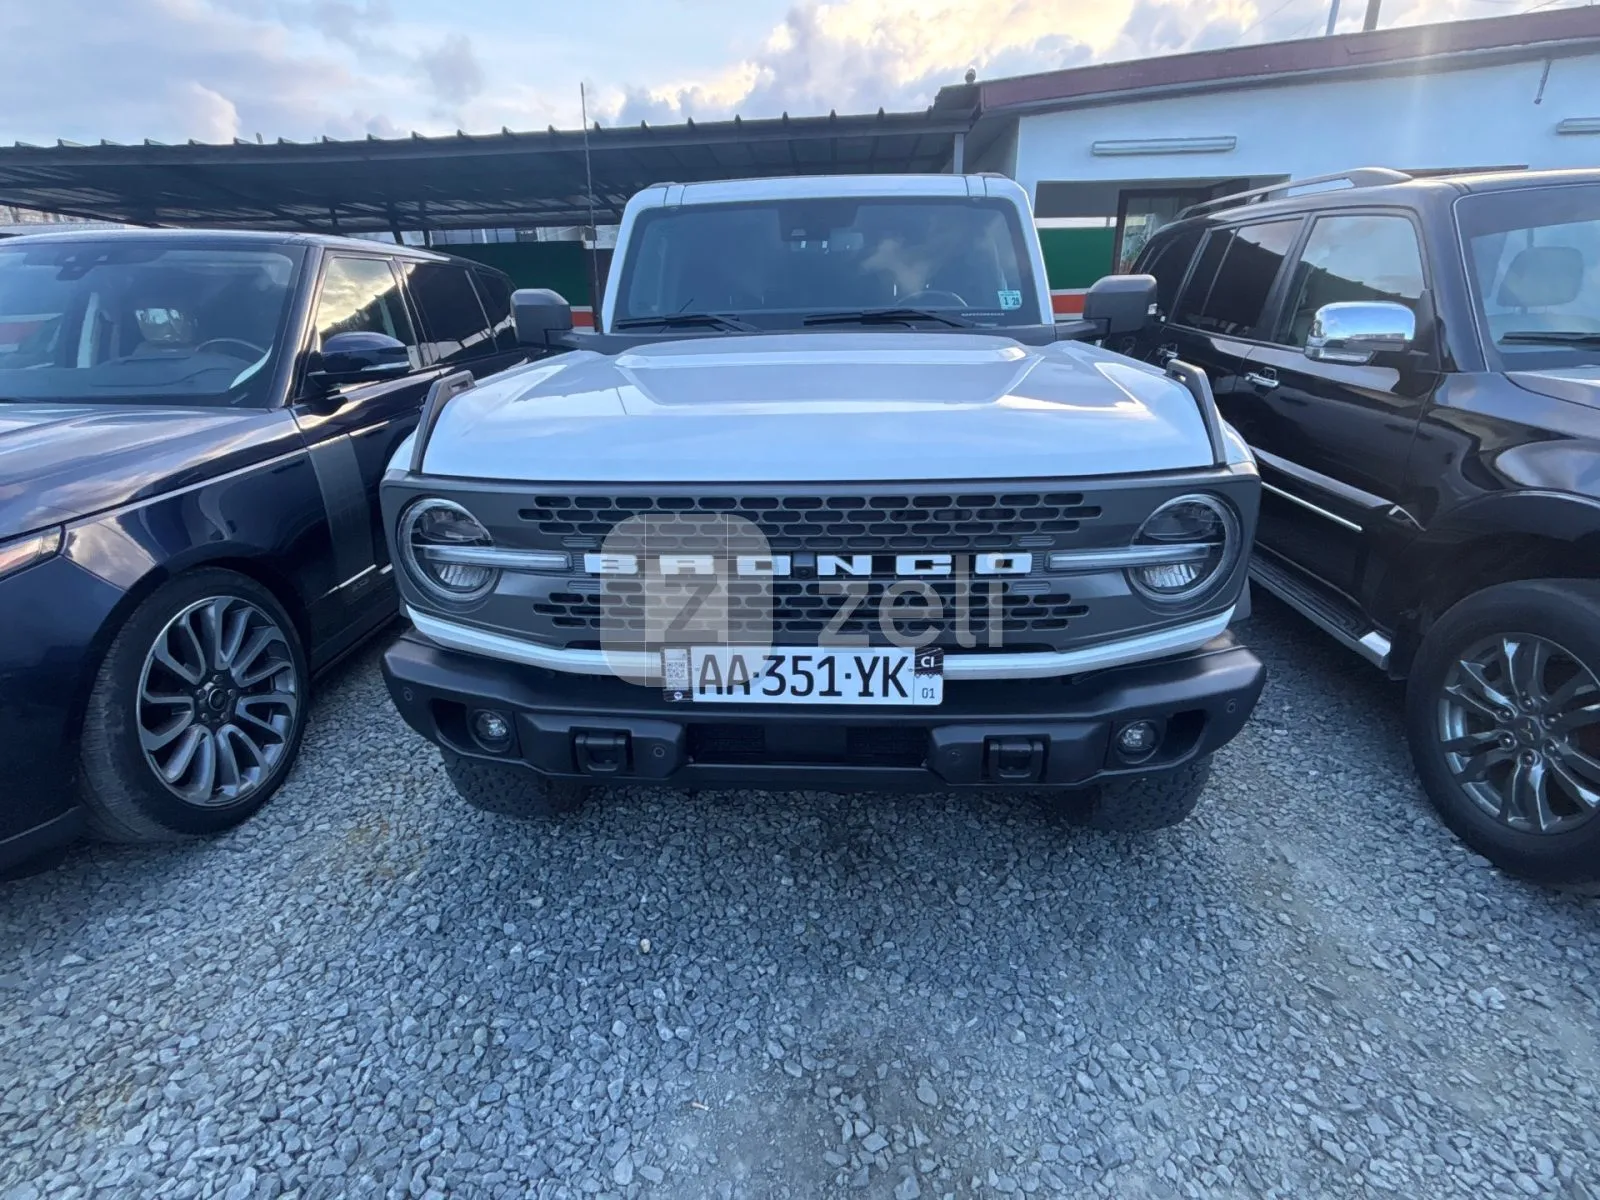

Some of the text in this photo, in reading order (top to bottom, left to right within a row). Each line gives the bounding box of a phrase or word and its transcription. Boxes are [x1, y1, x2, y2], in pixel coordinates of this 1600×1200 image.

[584, 554, 1031, 575] BRONCO
[921, 656, 935, 668] CI
[921, 687, 935, 699] 01
